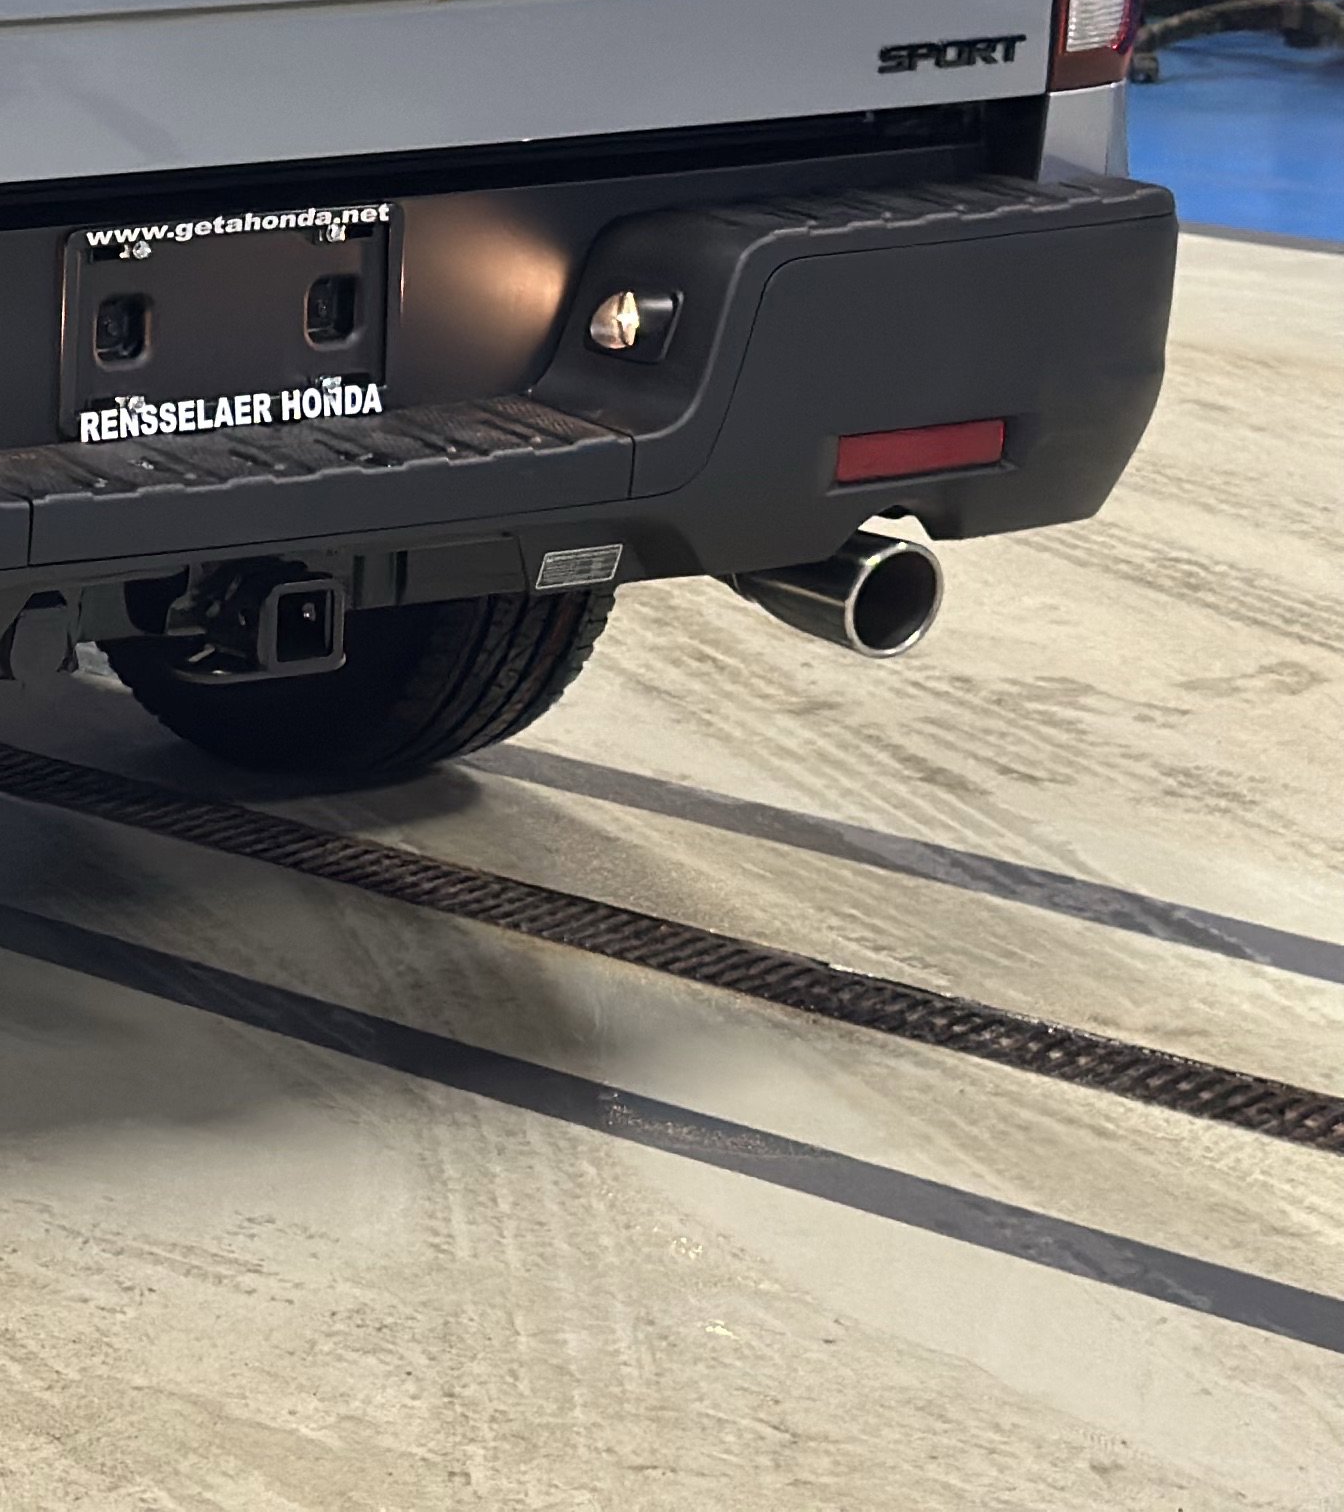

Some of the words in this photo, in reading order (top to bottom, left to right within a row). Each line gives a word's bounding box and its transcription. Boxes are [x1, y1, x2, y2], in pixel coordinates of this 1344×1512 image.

[877, 34, 1027, 74] SPORT
[86, 203, 391, 247] www.getahonda.net
[80, 392, 273, 444] RENSSELAER
[280, 383, 384, 421] HONDA
